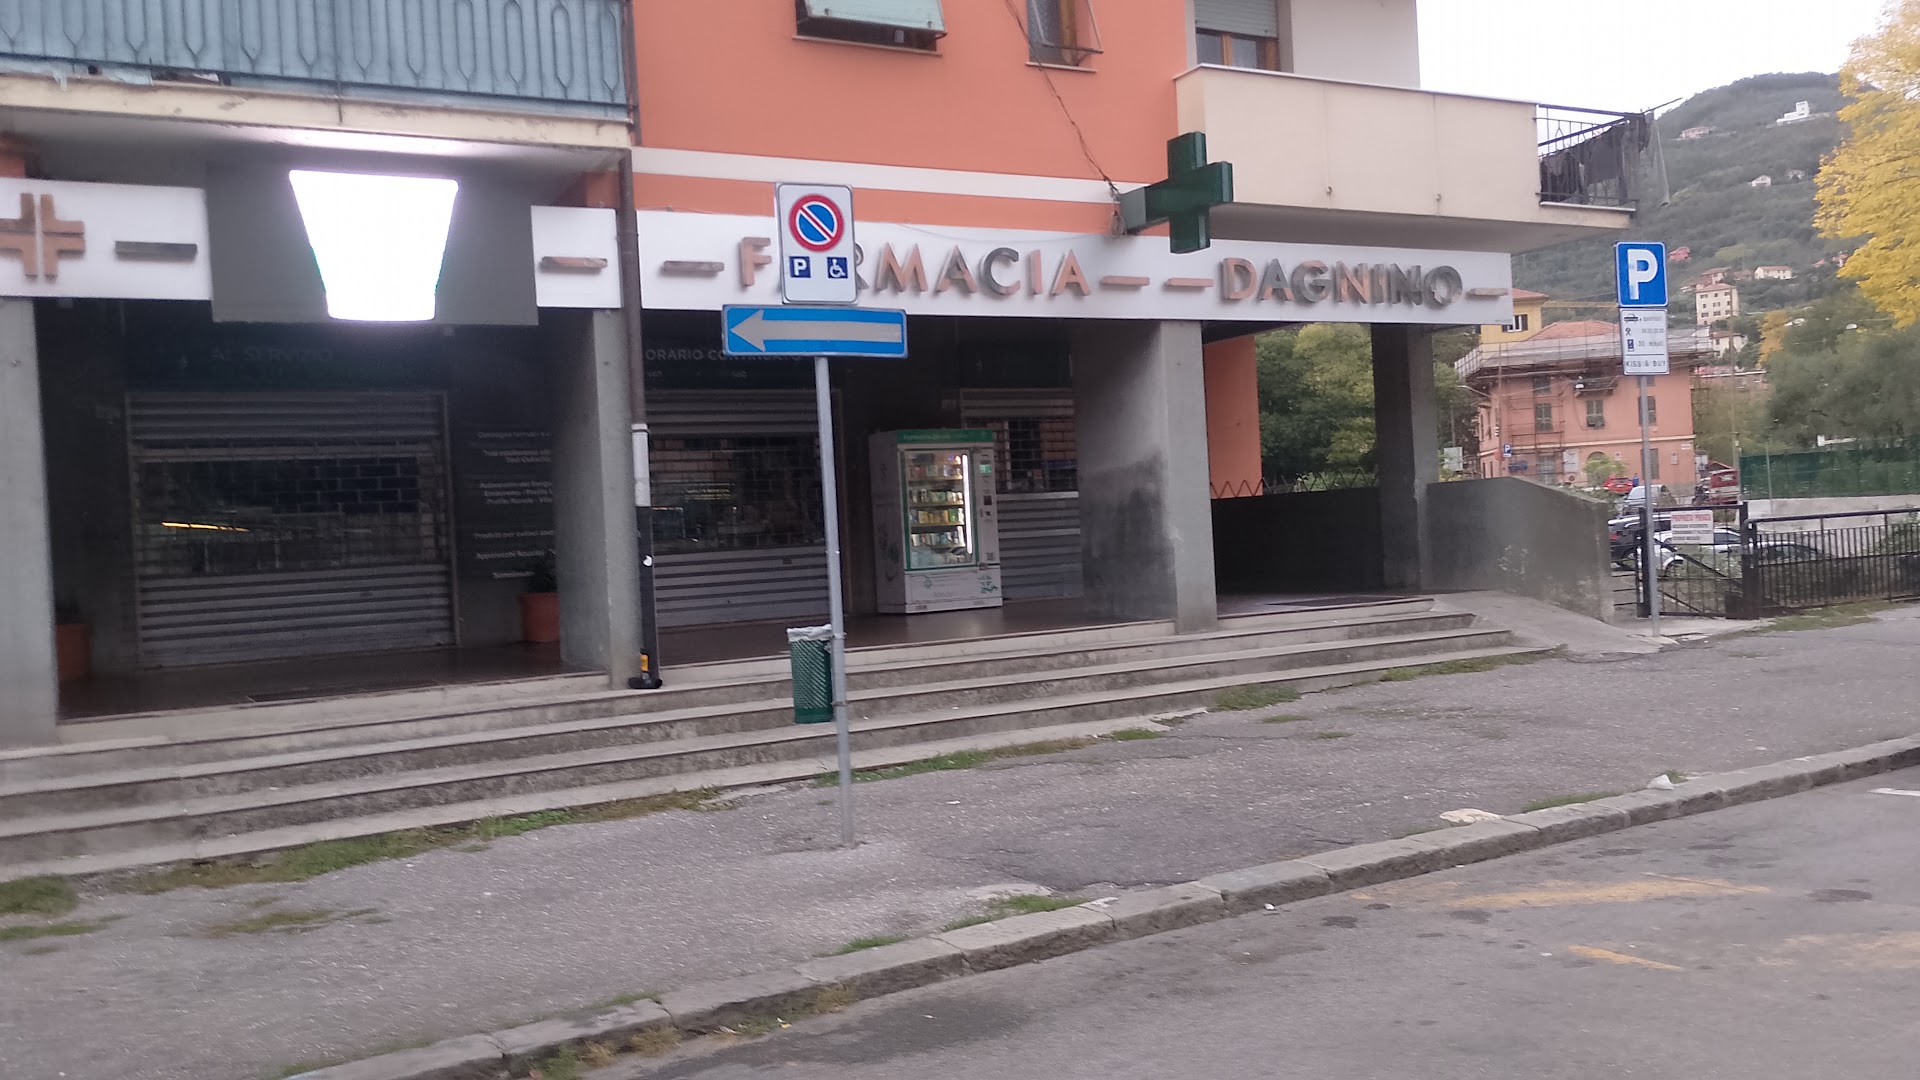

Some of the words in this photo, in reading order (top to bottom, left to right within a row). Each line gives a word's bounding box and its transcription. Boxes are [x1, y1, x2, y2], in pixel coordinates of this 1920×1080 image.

[793, 258, 808, 276] P
[1220, 257, 1463, 306] DAGNINO
[1627, 249, 1658, 300] P
[645, 349, 704, 361] ORARIO
